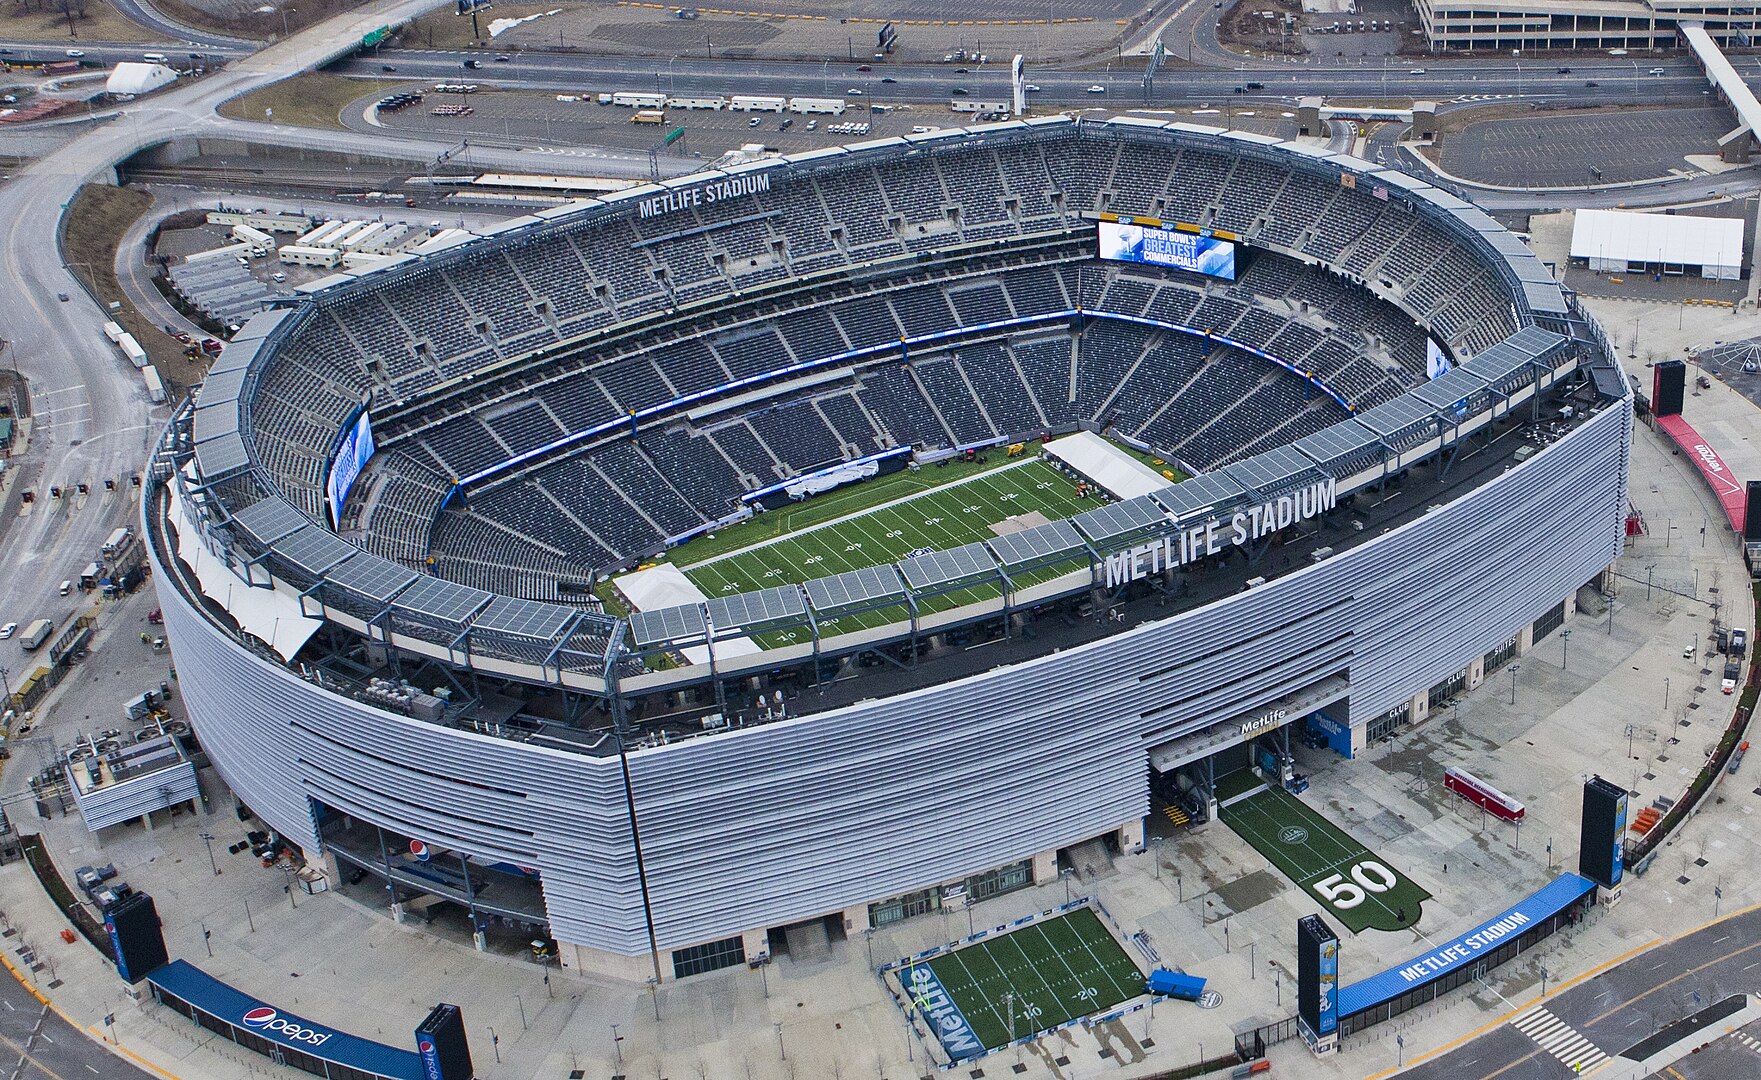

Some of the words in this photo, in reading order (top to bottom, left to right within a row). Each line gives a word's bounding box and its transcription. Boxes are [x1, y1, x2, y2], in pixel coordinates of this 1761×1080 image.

[639, 188, 702, 219] METLIFE
[705, 173, 771, 203] STADIUM
[1118, 216, 1131, 225] SAP
[1161, 222, 1174, 231] SAP
[1143, 227, 1168, 241] SUPER
[1169, 232, 1197, 246] BOWL'S
[1200, 228, 1212, 237] SAP
[1144, 238, 1197, 257] GREATEST
[1144, 251, 1198, 268] COMMERCIALS
[1694, 444, 1723, 472] verizon
[1106, 520, 1221, 588] METLIFE
[1231, 477, 1337, 546] STADIUM
[1494, 635, 1517, 656] SUITES
[1447, 668, 1466, 685] CLUB
[1389, 702, 1410, 718] CLUB
[1241, 709, 1286, 734] MetLife
[1312, 860, 1397, 910] 50
[1399, 943, 1471, 982] METLIFE
[1465, 911, 1531, 950] STADIUM
[1078, 987, 1098, 1001] 20
[908, 968, 980, 1053] MetLife
[1022, 1006, 1043, 1020] 10
[262, 1018, 332, 1046] pepsi
[425, 1057, 439, 1080] epsi
